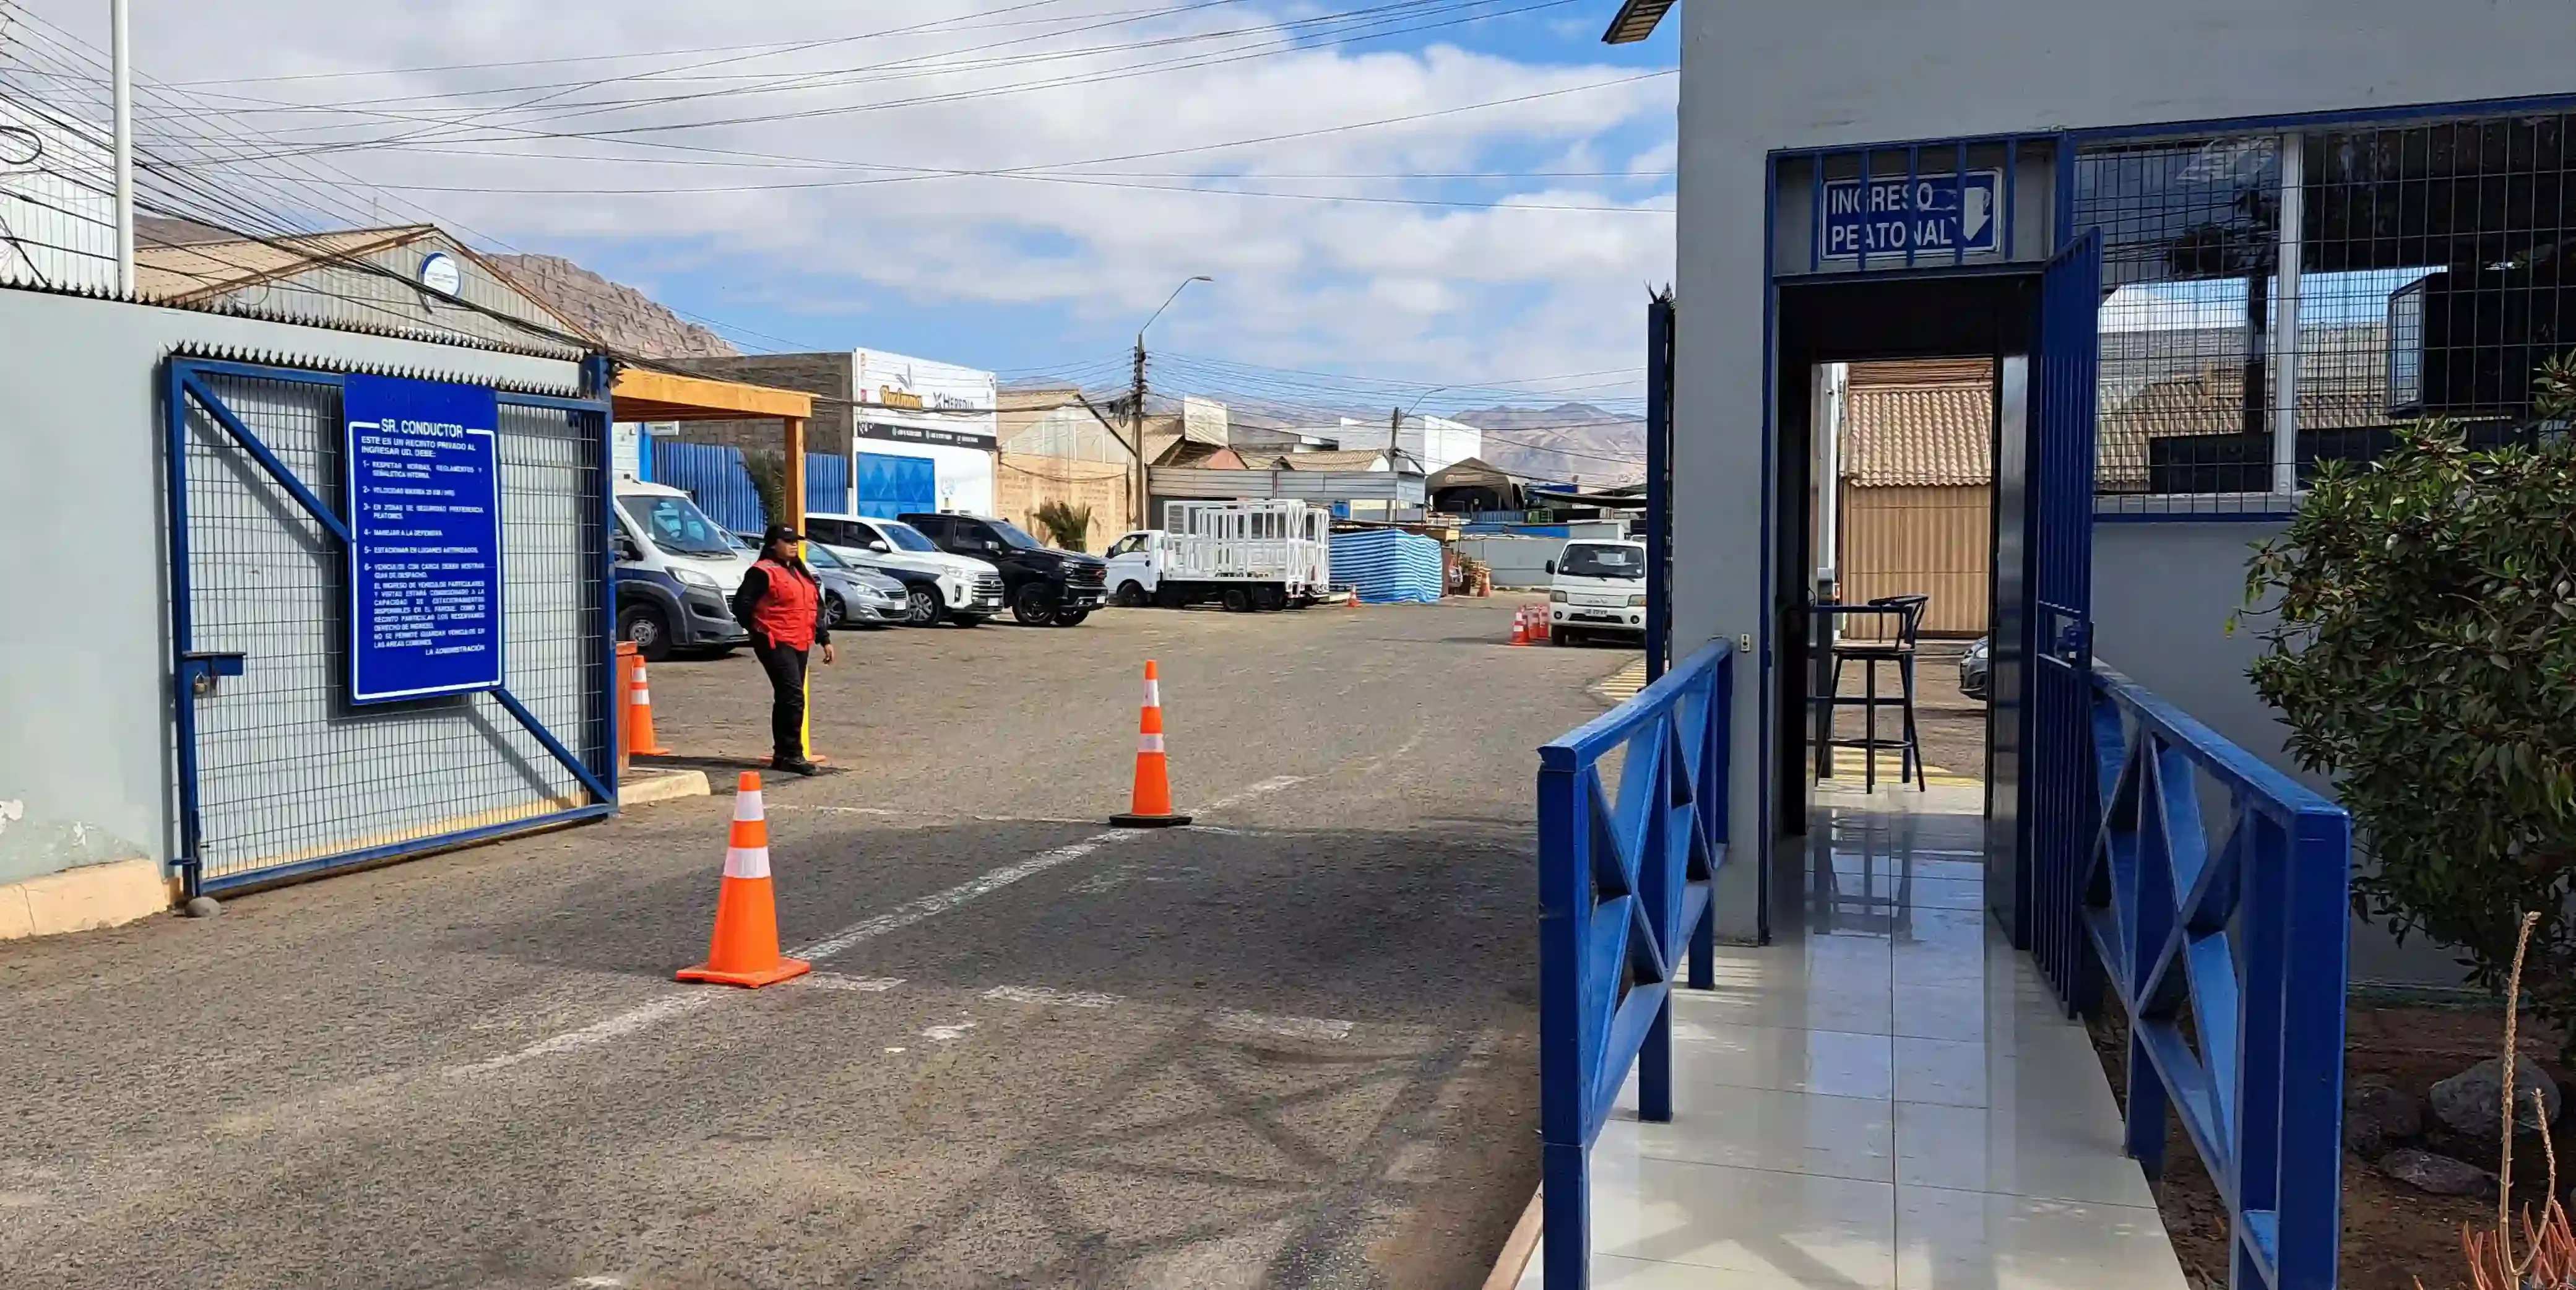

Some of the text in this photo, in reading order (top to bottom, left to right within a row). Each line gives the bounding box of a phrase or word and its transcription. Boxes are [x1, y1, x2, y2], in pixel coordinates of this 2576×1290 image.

[381, 418, 463, 438] SR. CONDUCTOR
[361, 436, 380, 444] ESTE
[405, 439, 436, 448] RECINTO
[437, 441, 466, 450] PRIVADO
[361, 446, 400, 456] INGRESAR
